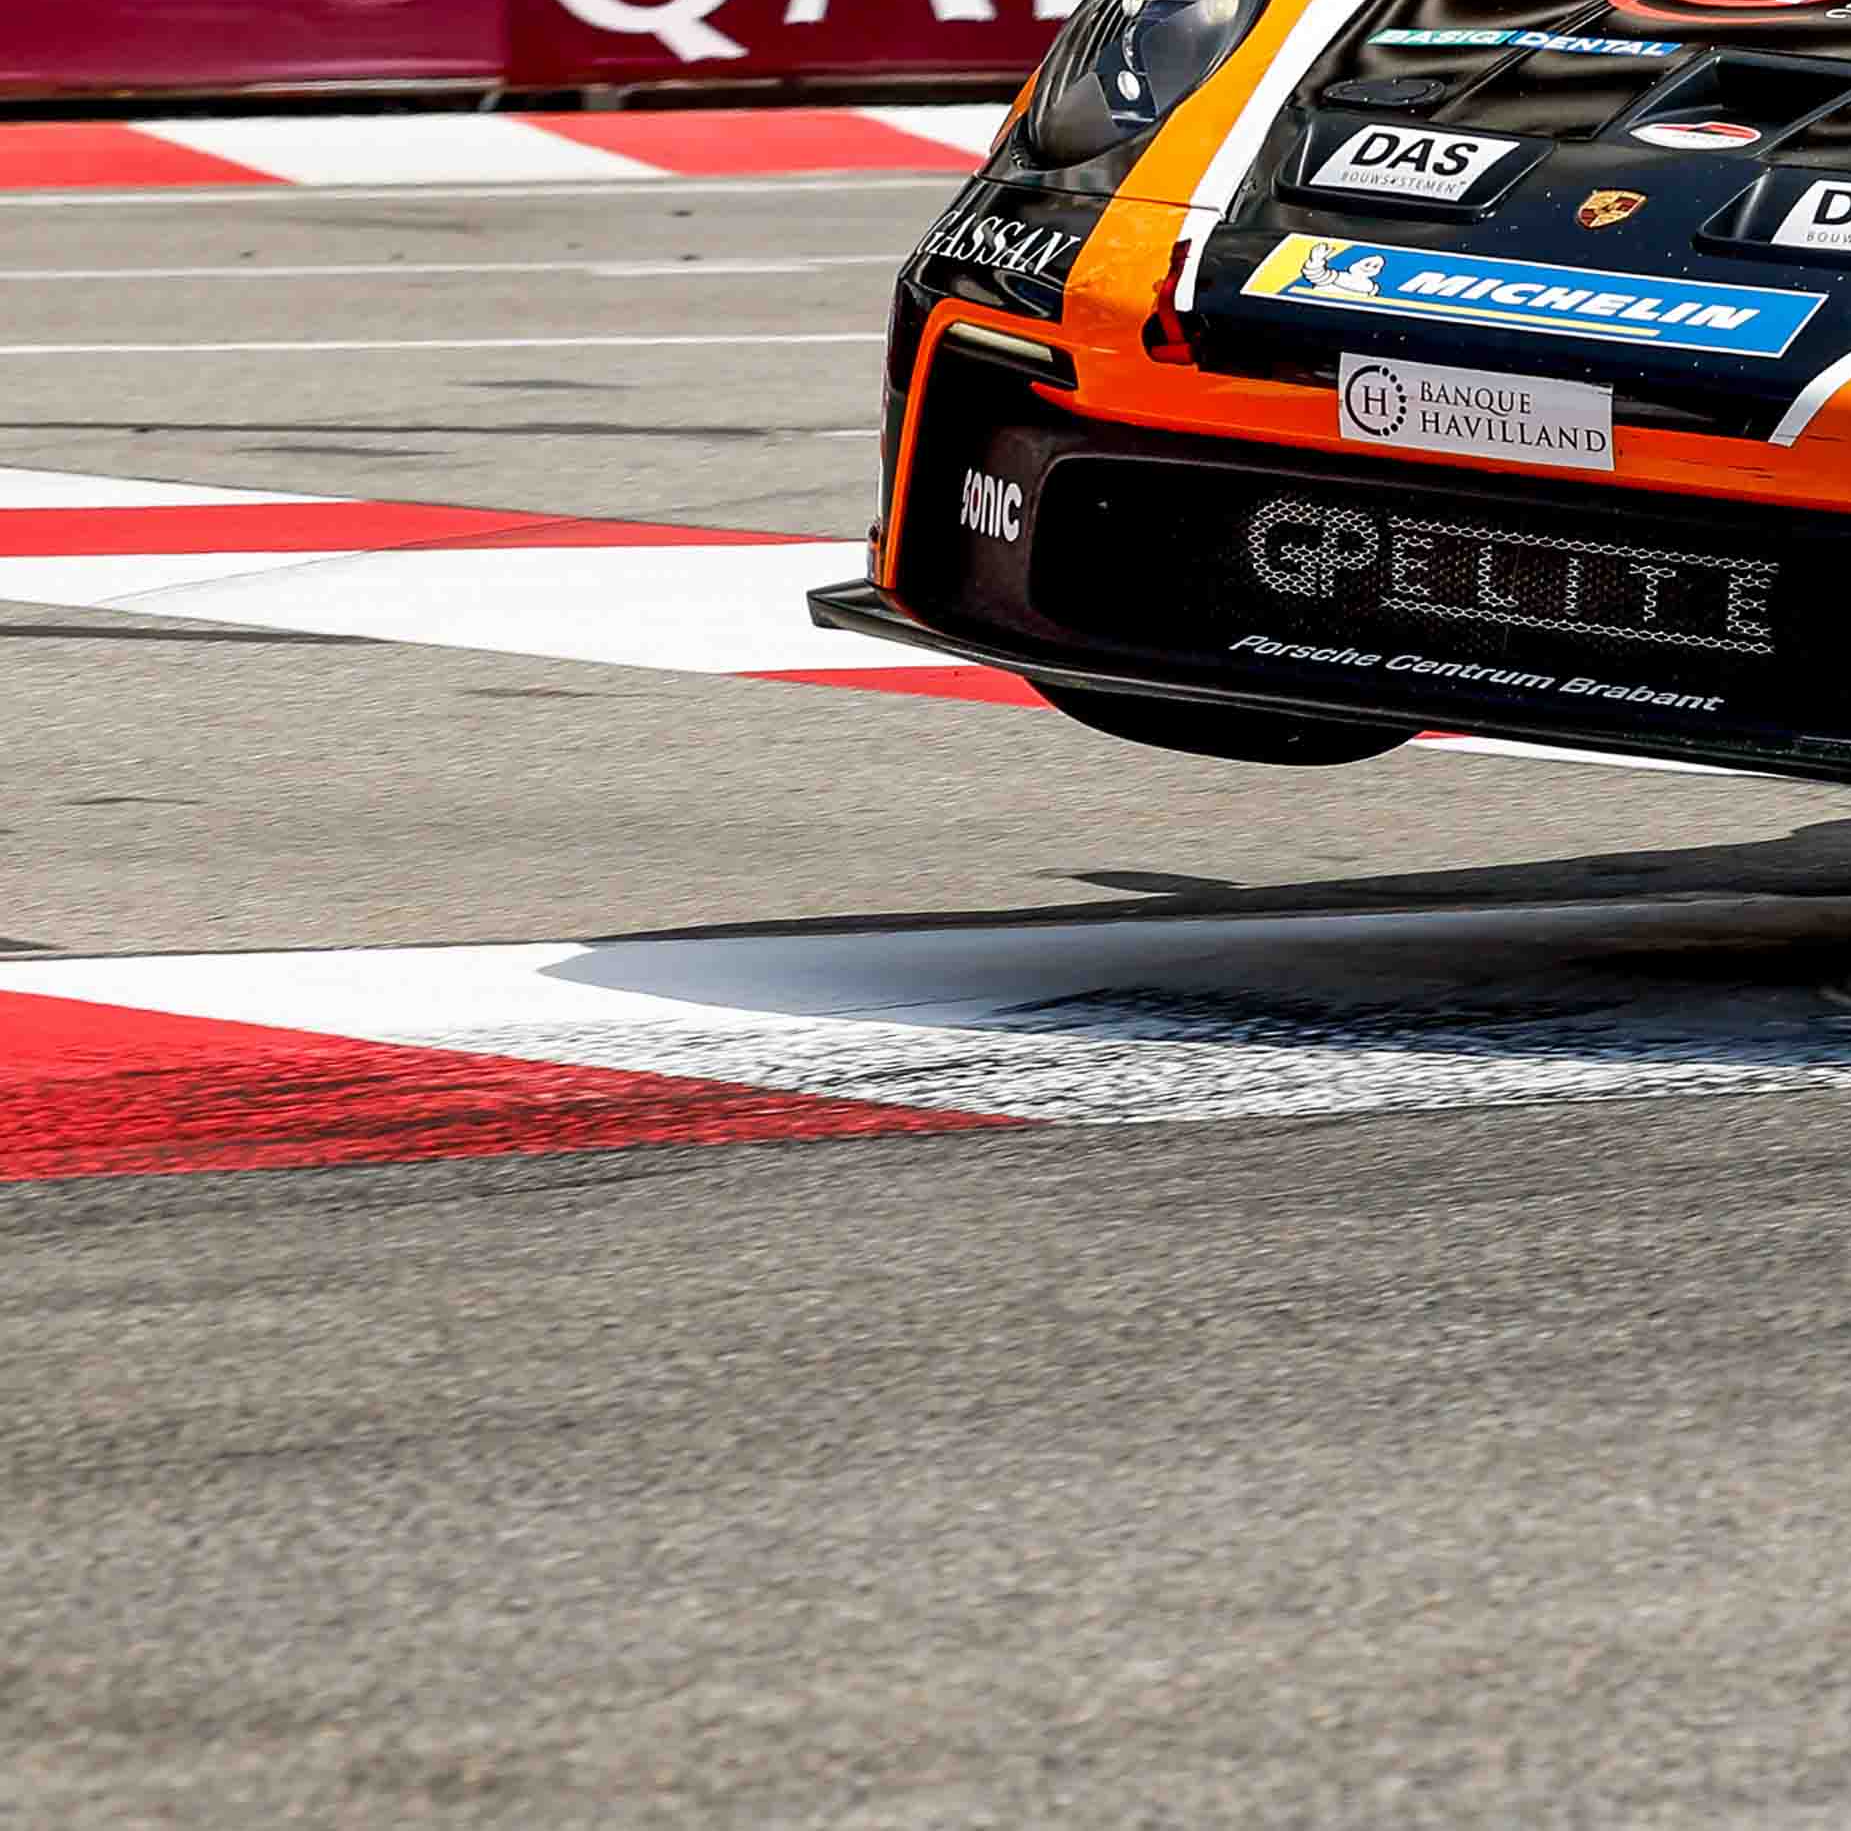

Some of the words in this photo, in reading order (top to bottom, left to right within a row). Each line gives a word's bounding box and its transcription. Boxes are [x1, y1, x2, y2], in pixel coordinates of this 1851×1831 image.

[1380, 29, 1504, 47] BASIQ
[1515, 31, 1670, 57] DENTAL
[1351, 132, 1479, 176] DAS
[1398, 271, 1762, 331] MICHELIN
[1419, 380, 1533, 417] BANQUE
[1419, 410, 1608, 456] HAVILLAND
[1386, 522, 1777, 648] ELITE
[1229, 633, 1382, 671] Porsche
[1386, 653, 1556, 692] Centrum
[1556, 677, 1725, 713] Brabant
